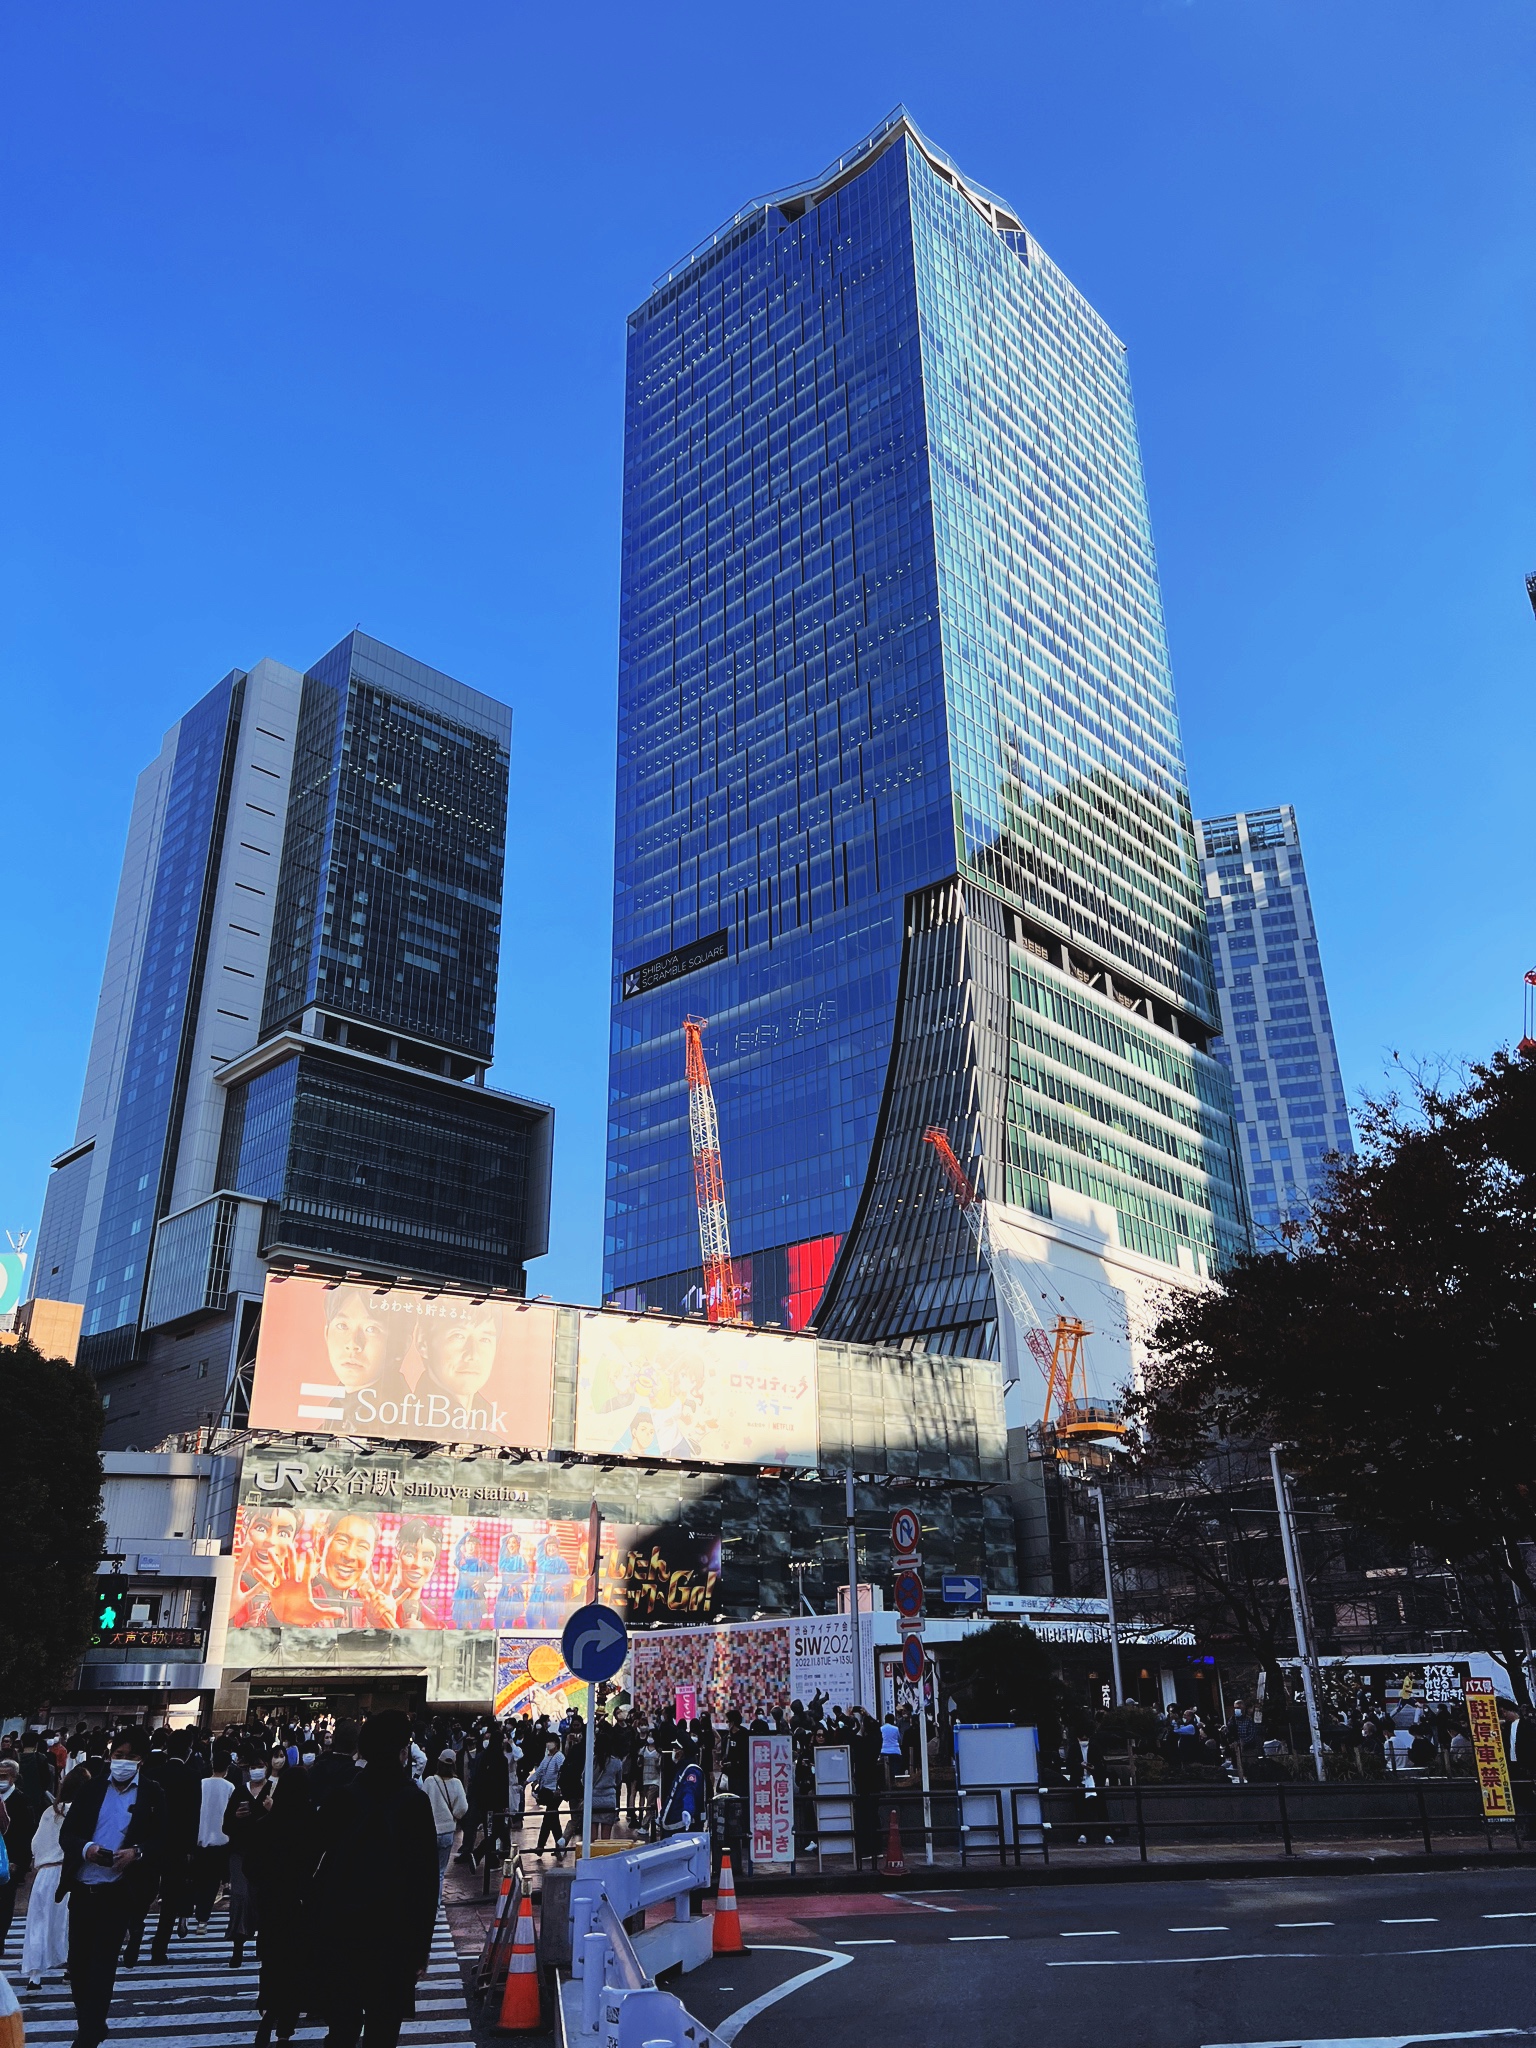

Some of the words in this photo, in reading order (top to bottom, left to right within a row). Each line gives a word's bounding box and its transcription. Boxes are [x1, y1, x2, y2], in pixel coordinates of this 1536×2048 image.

[642, 961, 687, 988] SCRAMBLE
[688, 944, 725, 969] SQUARE
[642, 955, 679, 978] SHIBUYA
[369, 1298, 472, 1320] しあわせも貯まるよ。
[730, 1374, 809, 1400] ロマンティック
[355, 1388, 509, 1433] SoftBank
[756, 1399, 793, 1416] キラー
[772, 1422, 795, 1432] NETFLIX
[254, 1461, 310, 1492] JR
[312, 1464, 401, 1497] 渋谷駅
[403, 1481, 472, 1501] shibuya
[473, 1485, 529, 1502] station
[795, 1621, 848, 1636] 渋谷アイデア会
[840, 1655, 854, 1665] 13SU
[1422, 1664, 1456, 1677] すべてを
[1424, 1676, 1450, 1689] みせる
[1425, 1688, 1465, 1702] ときがきた
[1469, 1699, 1506, 1811] 駐停車禁止
[754, 1745, 772, 1855] 駐停車禁止
[773, 1744, 790, 1854] バス停につき
